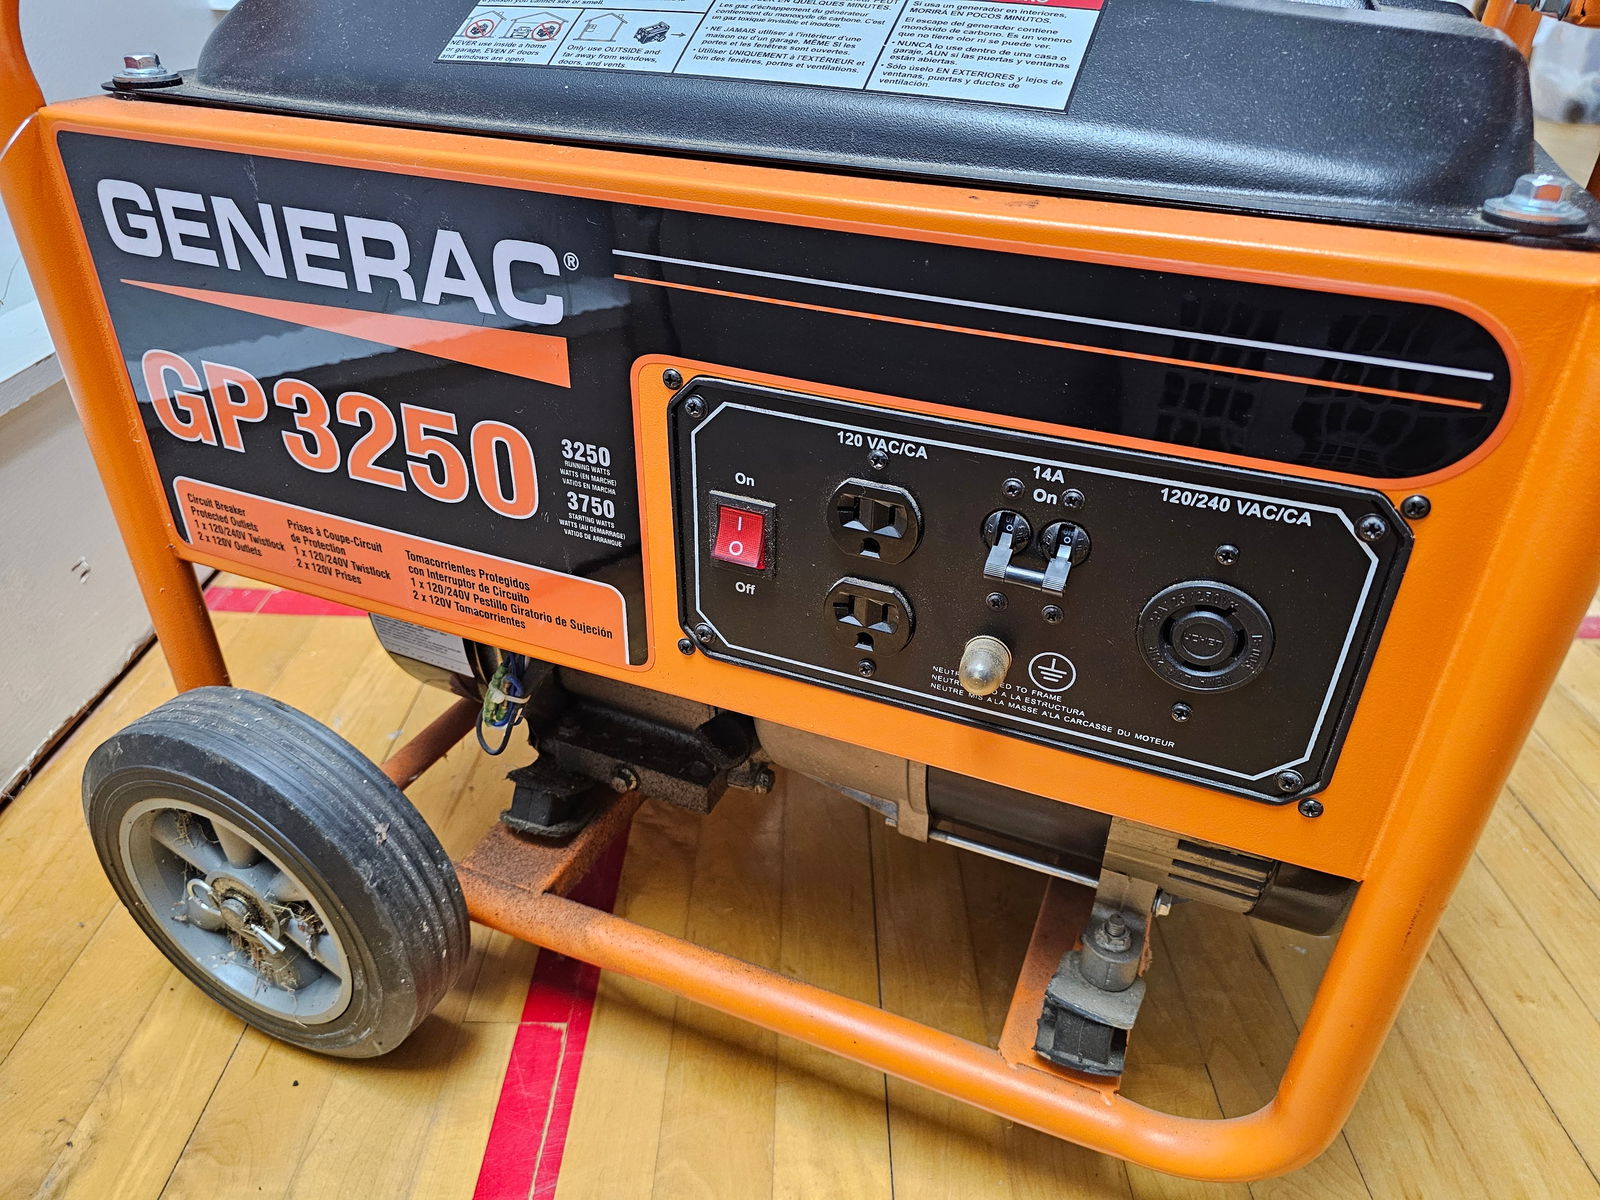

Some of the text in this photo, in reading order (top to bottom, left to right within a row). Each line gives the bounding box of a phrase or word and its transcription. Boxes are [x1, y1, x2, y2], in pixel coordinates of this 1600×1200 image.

[897, 40, 932, 48] NUNCA
[893, 48, 923, 58] garaje,
[1026, 60, 1070, 69] ventanas
[918, 57, 957, 65] abiertas.
[880, 79, 929, 87] ventilación.
[883, 71, 924, 80] ventanas,
[973, 79, 1005, 87] ductos
[1008, 81, 1020, 89] de
[952, 69, 1015, 80] EXTERIORES
[1026, 76, 1048, 84] lejos
[142, 349, 539, 521] GP3250
[837, 431, 928, 459] 120 VAC/CA
[561, 439, 611, 467] 3250
[560, 468, 579, 478] WATTS
[591, 475, 617, 486] MARCHE)
[564, 460, 610, 476] RUNNING WATTS
[1032, 466, 1065, 484] 14A
[562, 478, 616, 495] VATIOS EN MARCHA
[735, 472, 755, 487] On
[187, 493, 245, 516] Circuit Breaker
[567, 492, 615, 518] 3750
[1032, 488, 1058, 505] On
[1160, 488, 1313, 527] 120/240 VAC/CA
[191, 506, 259, 532] Protected Outlets
[559, 519, 578, 528] WATTS
[569, 513, 615, 529] STARTING WATTS
[194, 519, 286, 551] 1 x 120/240V Twistlock
[197, 531, 262, 556] 2 x 120V Outlets
[287, 519, 314, 535] Prises
[323, 529, 382, 552] Coupe-Circuit
[290, 533, 346, 555] de Protection
[564, 528, 583, 538] VATIOS
[593, 536, 622, 548] ARRANQUE
[293, 546, 391, 580] 1 x 120/240V Twistlock
[296, 558, 362, 584] 2 x 120V Prises
[405, 550, 530, 591] Tomacorrientes Protegidos
[408, 566, 530, 604] con Interruptor de Circuito
[735, 581, 756, 595] Off
[410, 577, 612, 639] 1 x 120/240V Pestillo Giratorio de Sujeción
[413, 590, 525, 629] 2 x 120V Tomacorrientes
[1016, 686, 1028, 694] TO
[1032, 690, 1062, 702] FRAME
[930, 682, 964, 696] NEUTRE
[1008, 702, 1038, 714] MASSE
[1064, 716, 1112, 733] CARCASSE
[1117, 729, 1131, 737] DU
[1135, 733, 1175, 748] MOTEUR
[1025, 697, 1085, 716] ESTRUCTURA
